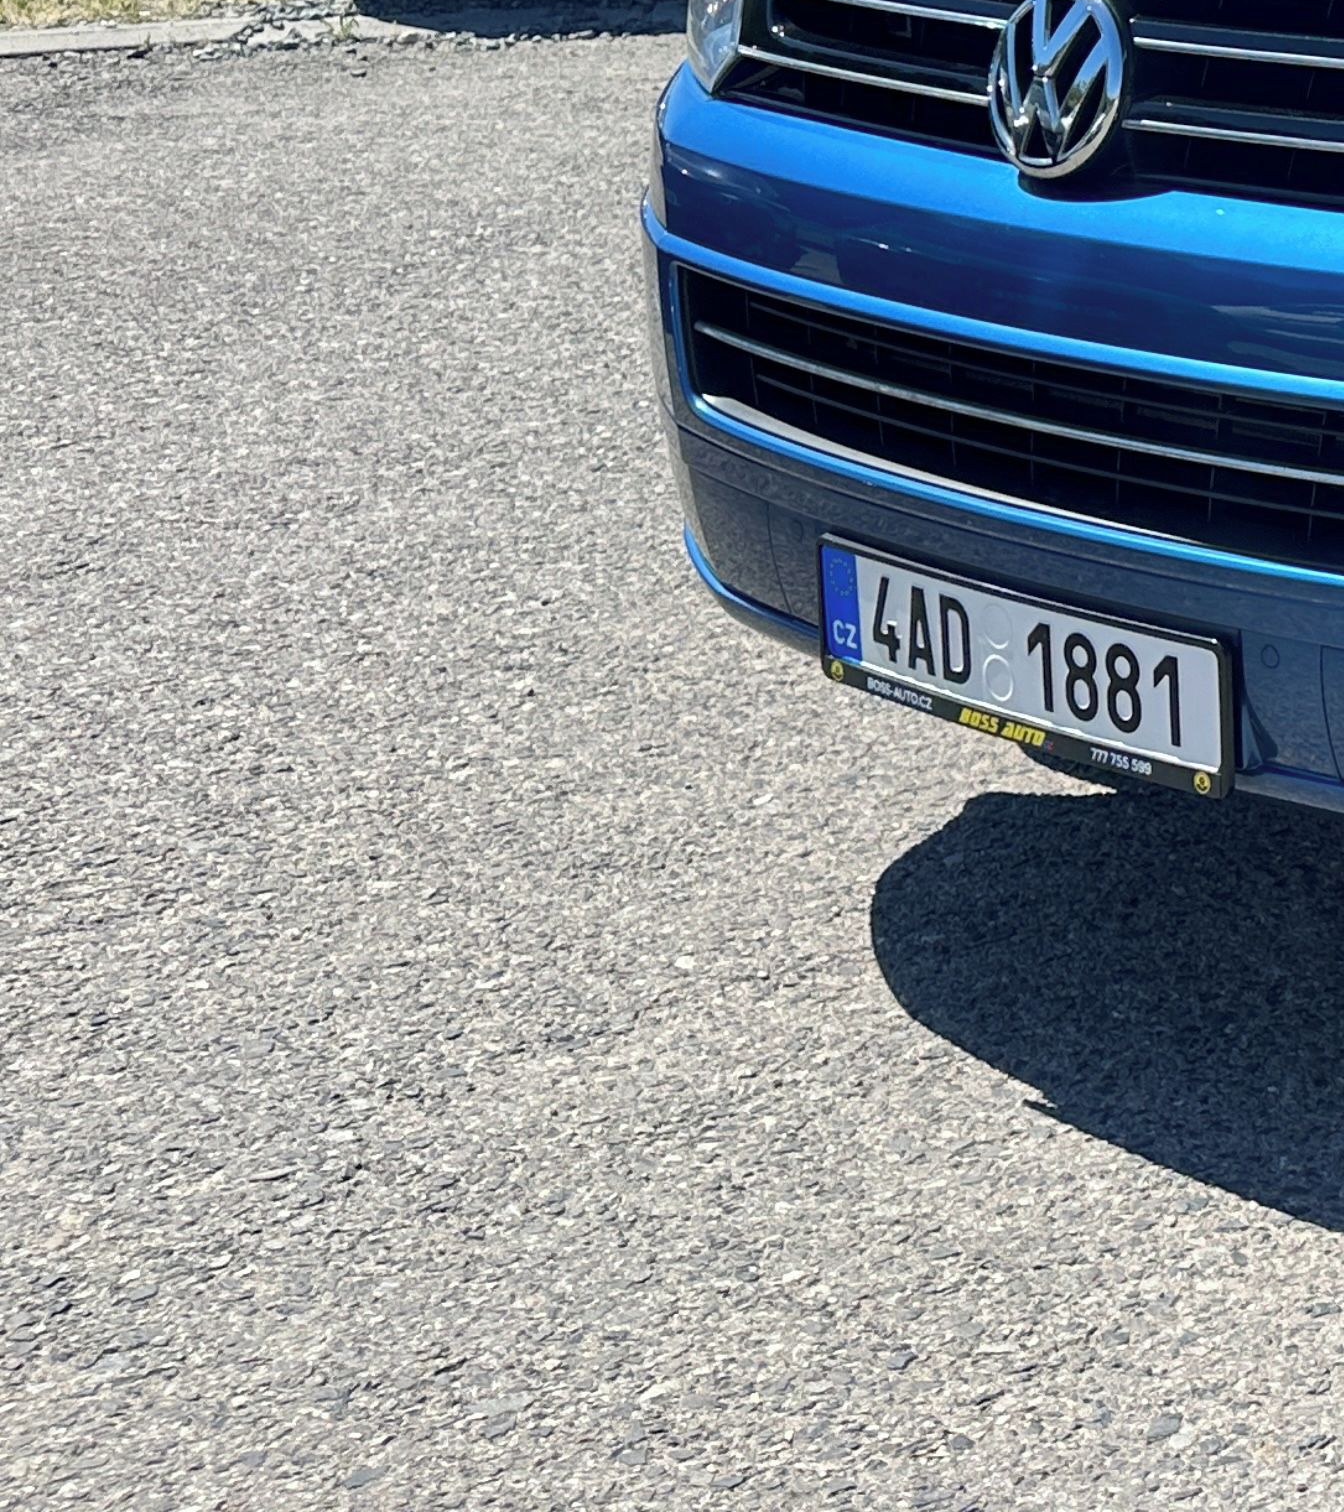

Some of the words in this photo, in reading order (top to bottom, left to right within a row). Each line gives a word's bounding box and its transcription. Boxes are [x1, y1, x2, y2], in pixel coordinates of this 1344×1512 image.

[832, 619, 858, 649] CZ
[873, 576, 973, 685] 4AD
[1027, 622, 1182, 748] 1881
[958, 707, 1001, 733] BOSS
[1001, 721, 1047, 747] AUTO
